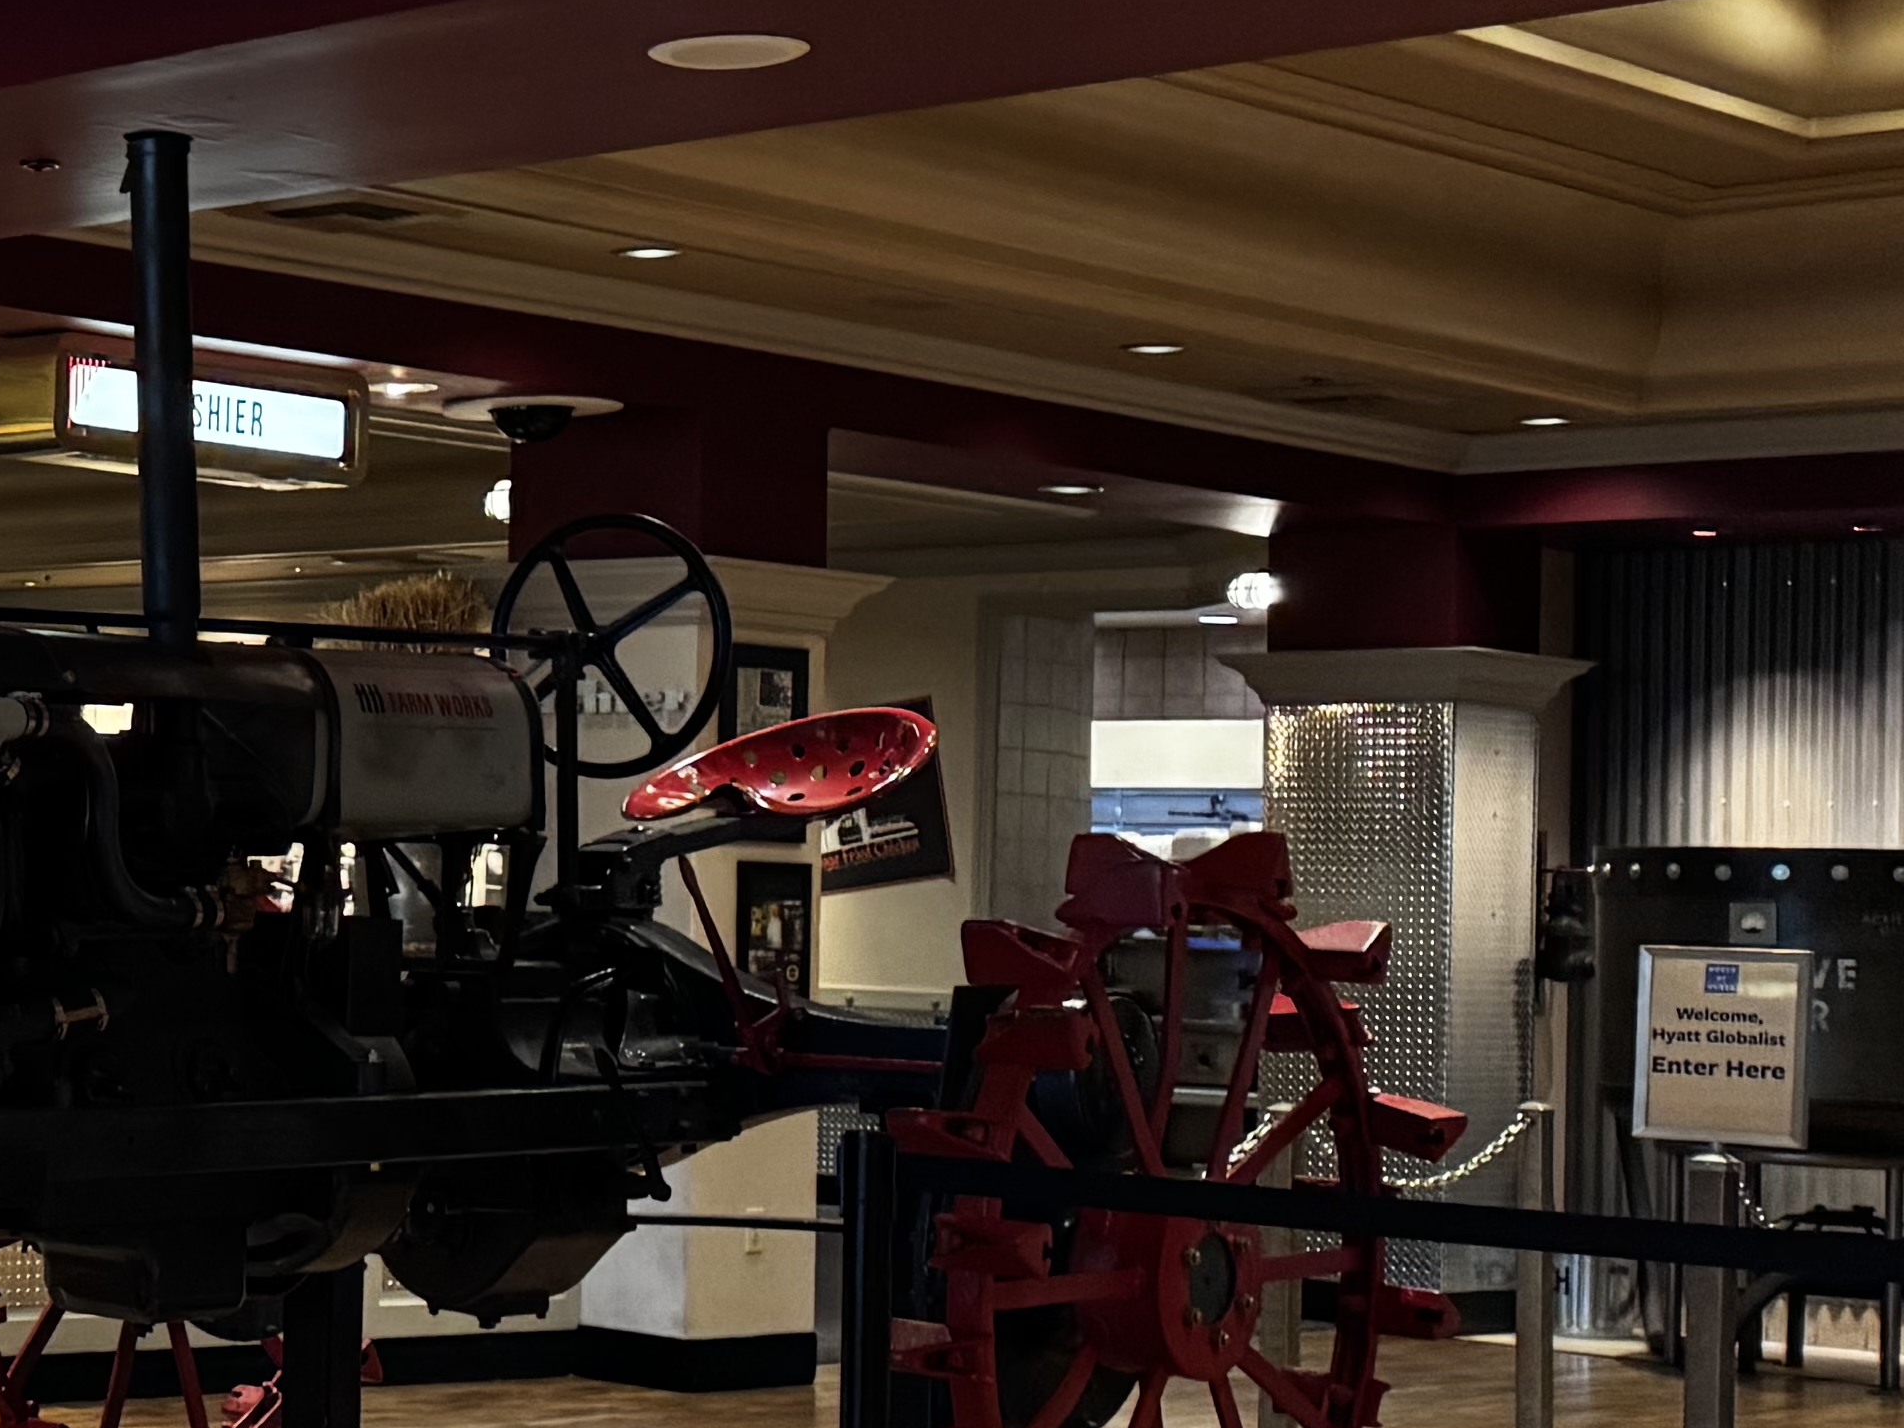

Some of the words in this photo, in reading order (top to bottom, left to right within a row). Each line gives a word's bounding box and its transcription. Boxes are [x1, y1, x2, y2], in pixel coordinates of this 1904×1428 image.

[192, 393, 263, 437] SHIER
[387, 692, 434, 716] FARM
[434, 694, 494, 719] WORKS
[1676, 1007, 1764, 1025] Welcome,
[1652, 1027, 1702, 1045] Hyatt
[1707, 1030, 1786, 1047] Globalist
[1651, 1056, 1720, 1076] Enter
[1726, 1059, 1786, 1080] Here
